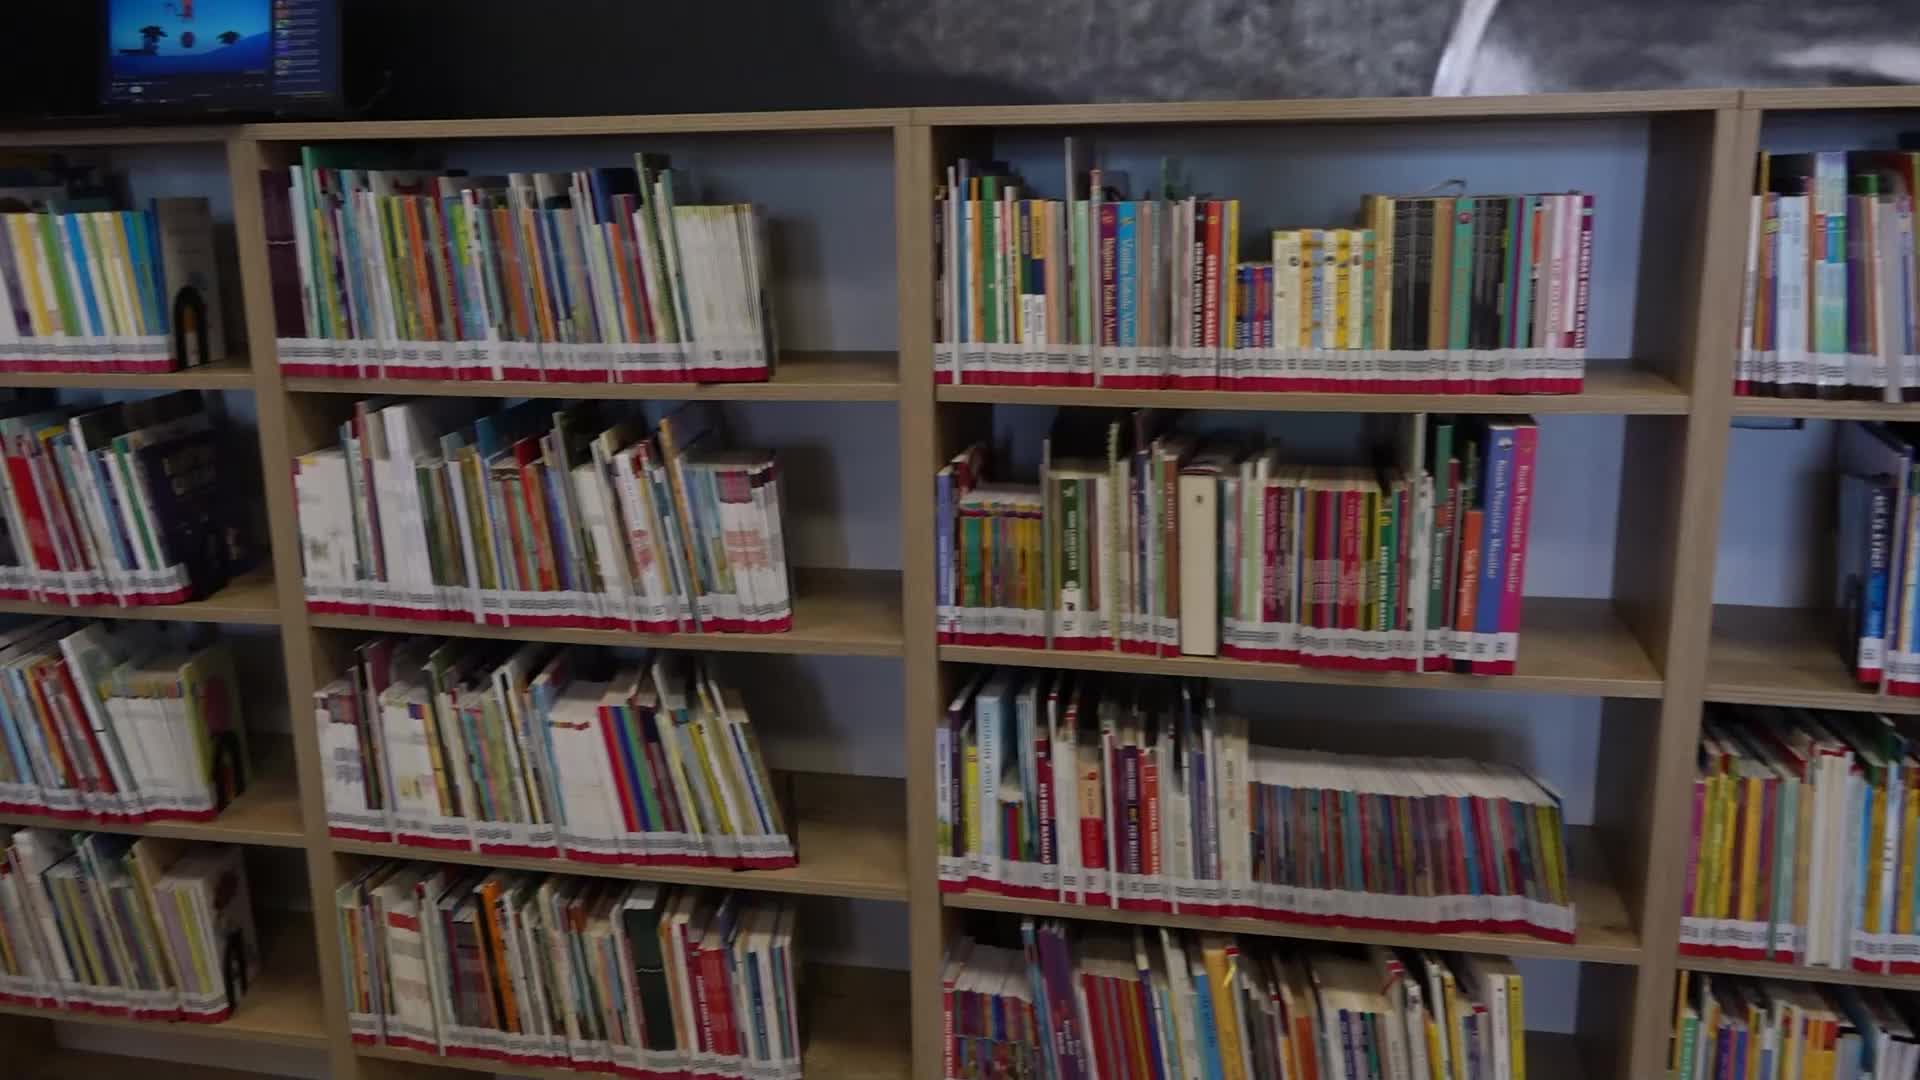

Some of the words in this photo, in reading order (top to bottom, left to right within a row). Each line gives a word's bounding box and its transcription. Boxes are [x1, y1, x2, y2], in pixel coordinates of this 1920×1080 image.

[1103, 284, 1117, 315] Kokulu
[1487, 538, 1501, 579] Masallar
[1506, 552, 1521, 593] Masallar
